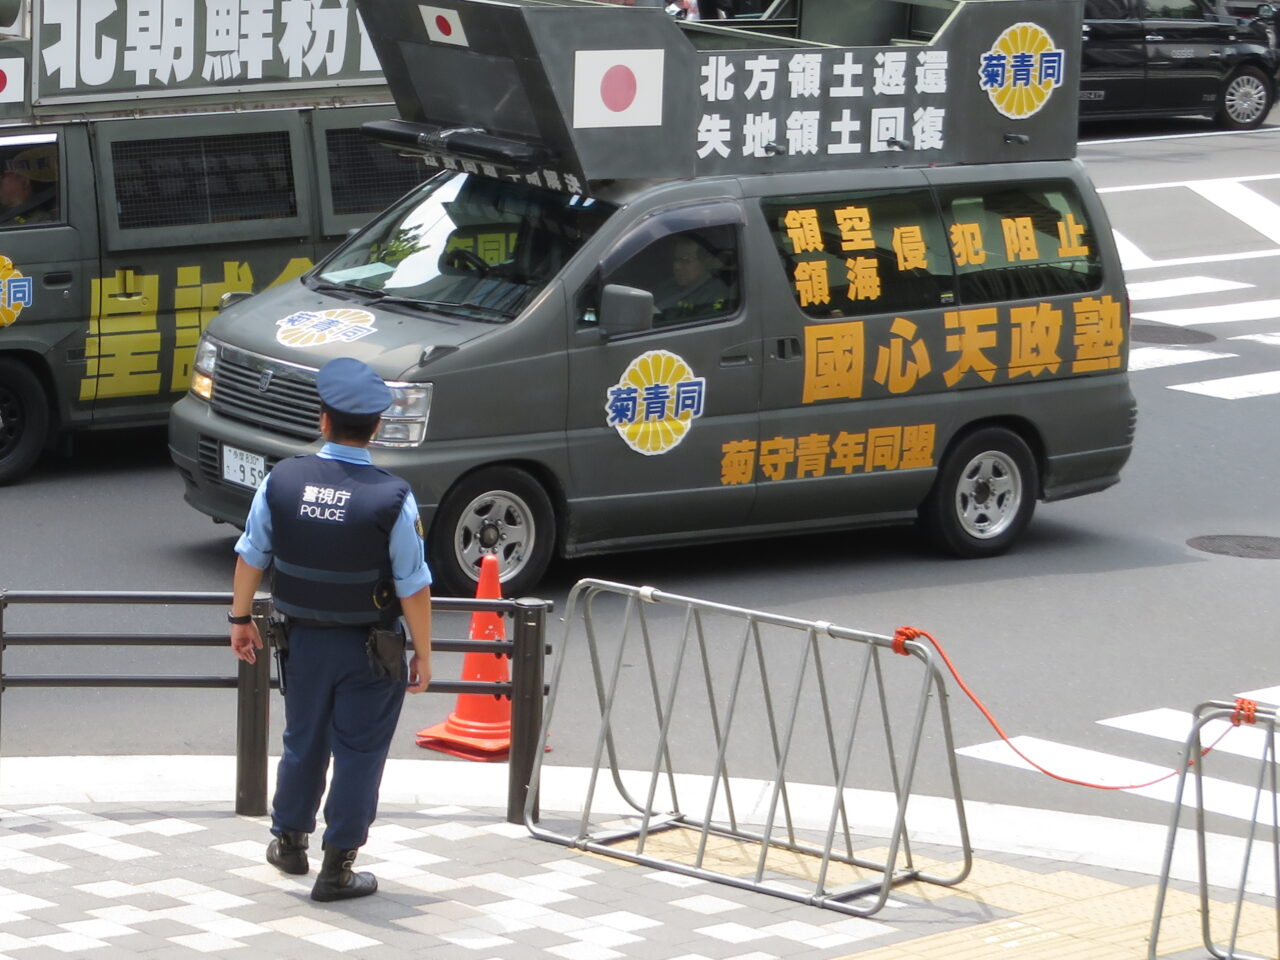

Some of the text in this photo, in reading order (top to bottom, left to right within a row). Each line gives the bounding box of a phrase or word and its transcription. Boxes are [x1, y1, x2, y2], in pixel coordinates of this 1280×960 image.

[699, 50, 948, 102] 北方領土返還
[981, 51, 1064, 90] 菊青同
[696, 106, 946, 159] 失地領土回復
[784, 206, 876, 255] 領空
[892, 213, 1089, 272] 侵犯阻止
[793, 256, 882, 307] 領海
[79, 257, 314, 401] 皇誠
[802, 295, 1124, 404] 國心天政塾
[608, 380, 705, 425] 菊青同
[720, 423, 936, 486] 菊守青年同盟
[300, 504, 346, 522] POLICE
[302, 485, 352, 507] 警視庁
